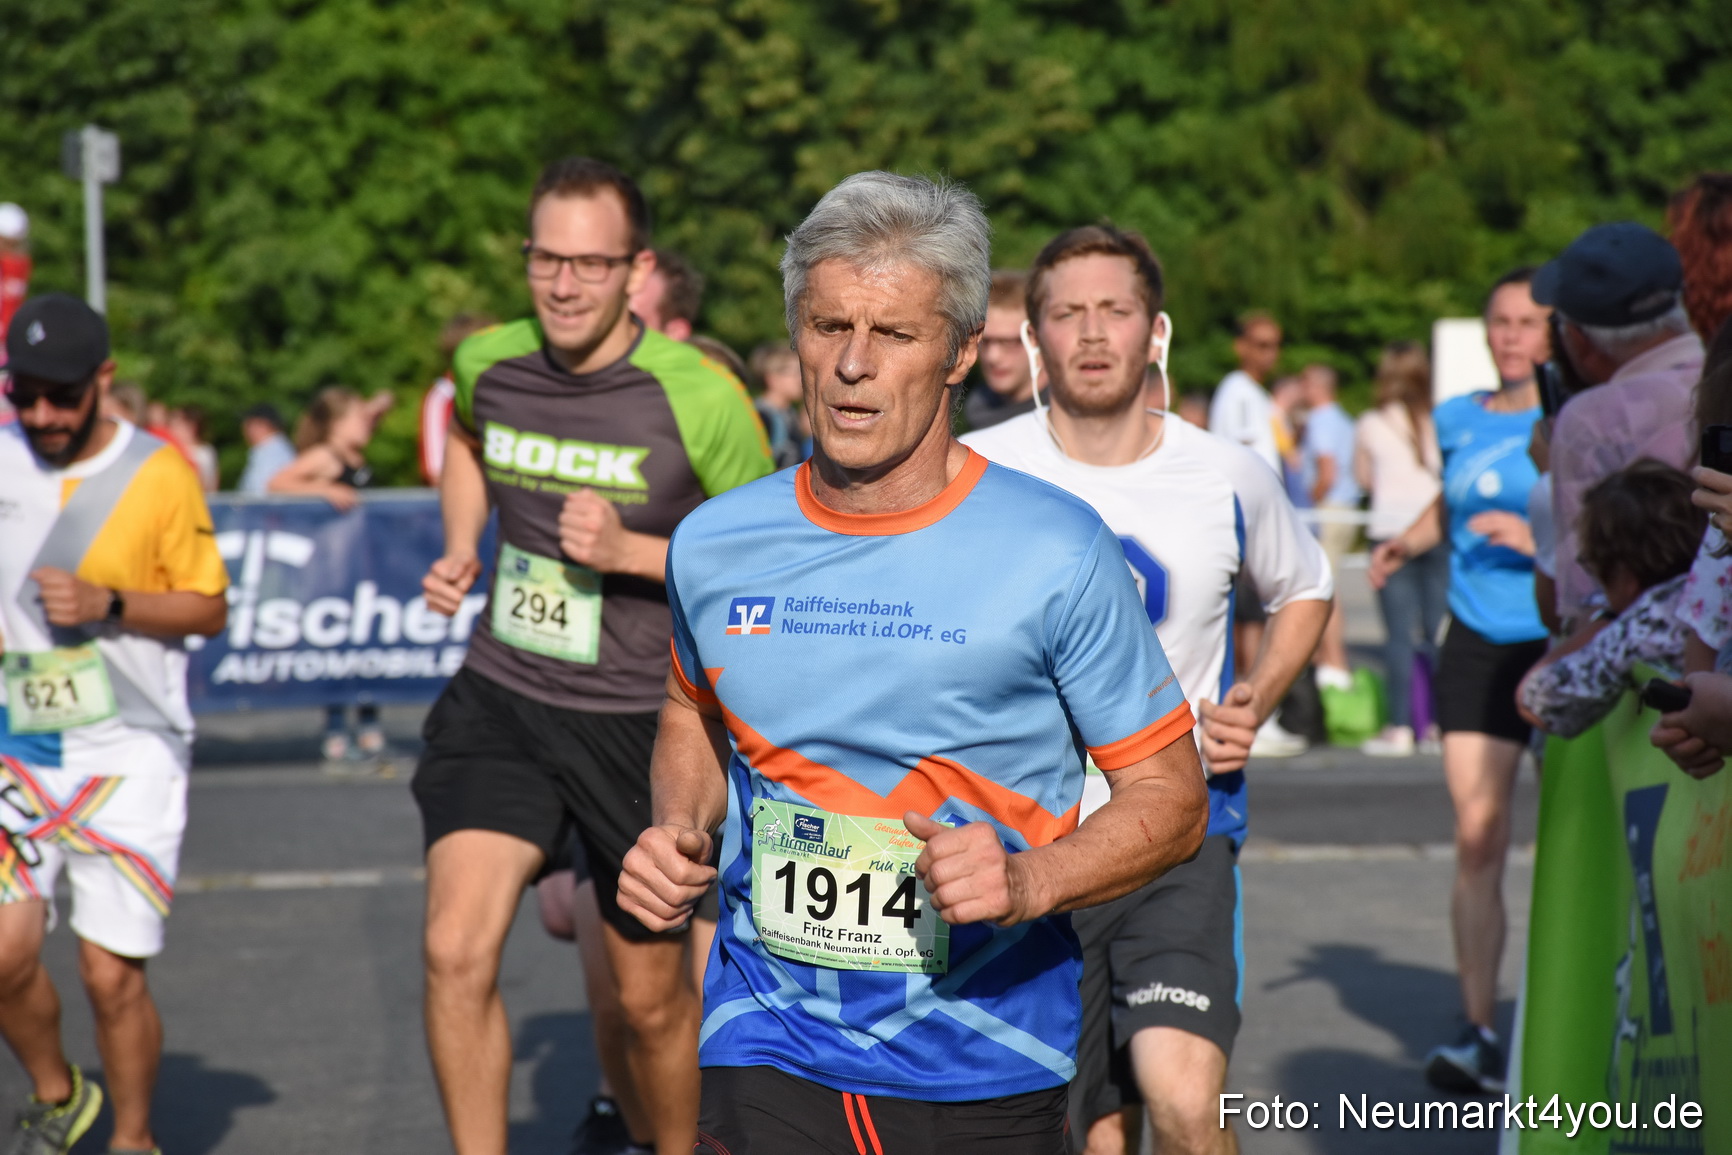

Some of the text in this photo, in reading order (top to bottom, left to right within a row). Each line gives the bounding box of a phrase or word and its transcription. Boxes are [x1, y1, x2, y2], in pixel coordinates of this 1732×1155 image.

[511, 587, 568, 629] 294
[784, 595, 915, 618] Raiffeisenbank
[781, 617, 867, 637] Neumarkt
[940, 628, 967, 645] eG
[22, 677, 79, 710] 621
[780, 832, 853, 860] firmenlauf
[780, 848, 810, 858] neumarkt
[868, 859, 894, 872] run
[775, 860, 922, 929] 1914
[761, 926, 822, 949] Raiffeisenbank
[823, 941, 871, 955] Neumarkt
[873, 946, 880, 956] i.
[882, 947, 892, 956] d.
[895, 947, 917, 959] Opf.
[919, 949, 934, 958] eG
[803, 921, 882, 944] Fritz Franz
